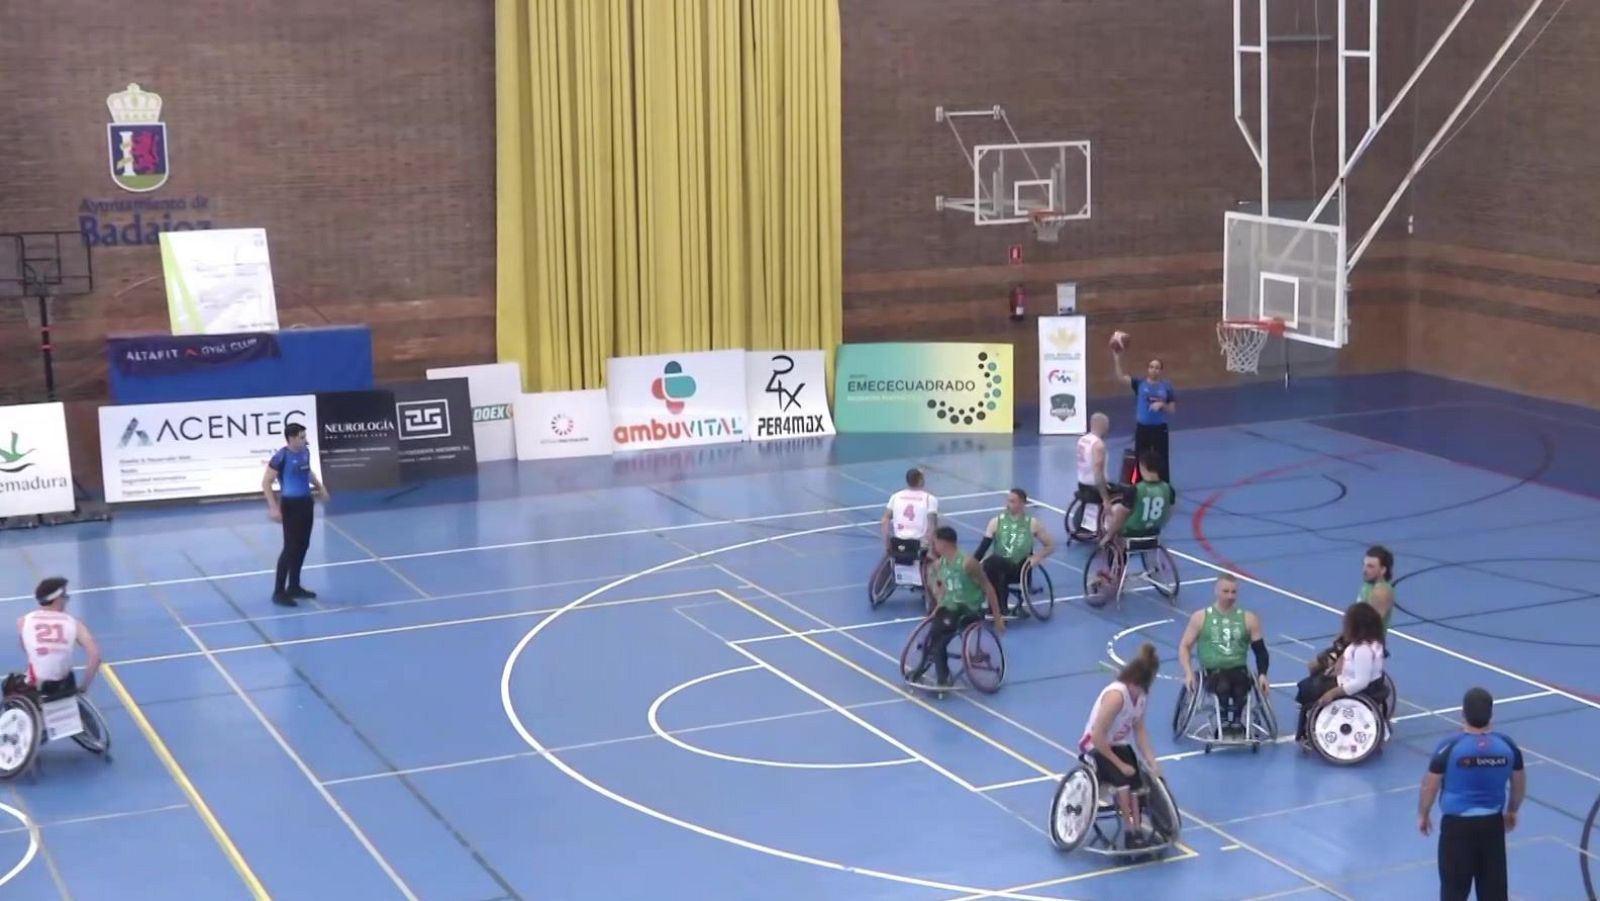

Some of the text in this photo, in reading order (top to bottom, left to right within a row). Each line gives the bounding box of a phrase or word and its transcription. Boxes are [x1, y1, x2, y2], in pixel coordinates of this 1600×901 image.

[126, 348, 180, 361] ALTAFIT
[847, 379, 976, 392] EMECECUADRADO
[324, 419, 395, 433] NEUROLOGÍA
[613, 418, 744, 444] ambuVITAL
[903, 504, 915, 521] 4
[1141, 496, 1165, 521] 18
[35, 623, 68, 644] 21
